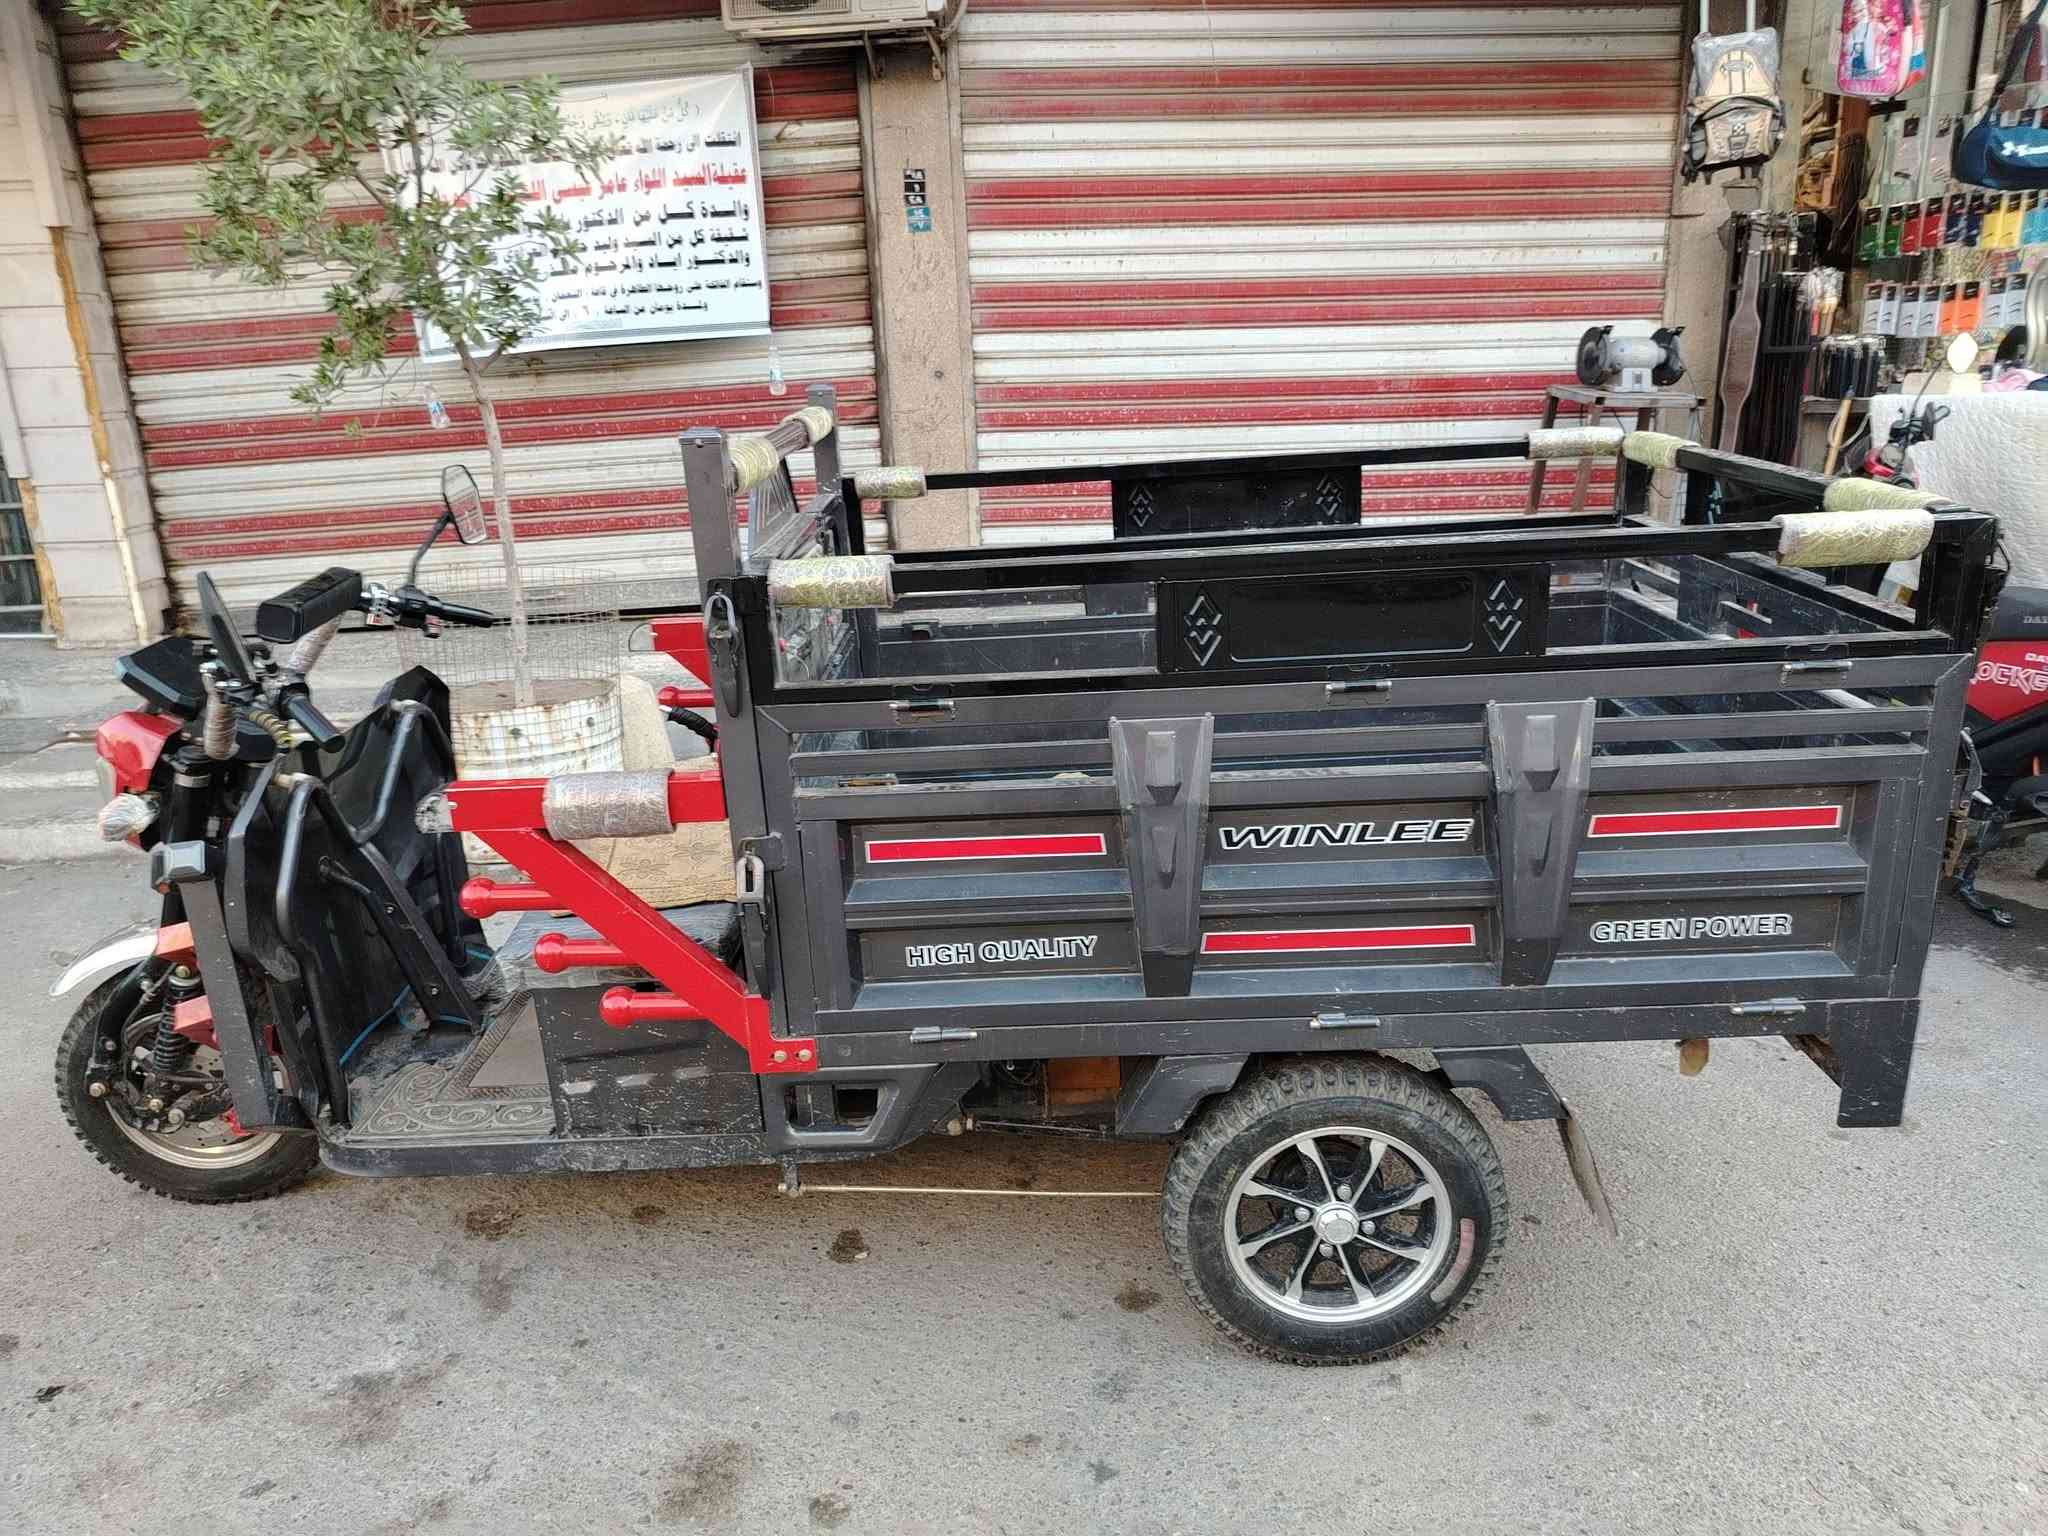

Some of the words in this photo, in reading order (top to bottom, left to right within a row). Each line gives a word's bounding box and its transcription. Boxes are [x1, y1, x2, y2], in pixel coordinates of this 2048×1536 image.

[632, 209, 652, 228] من
[667, 233, 683, 249] من
[689, 229, 706, 249] كل
[1219, 818, 1474, 850] WINLEE
[1589, 918, 1686, 943] GREEN
[1688, 913, 1793, 939] POWER
[905, 942, 976, 967] HIGH
[978, 935, 1098, 962] QUALITY
